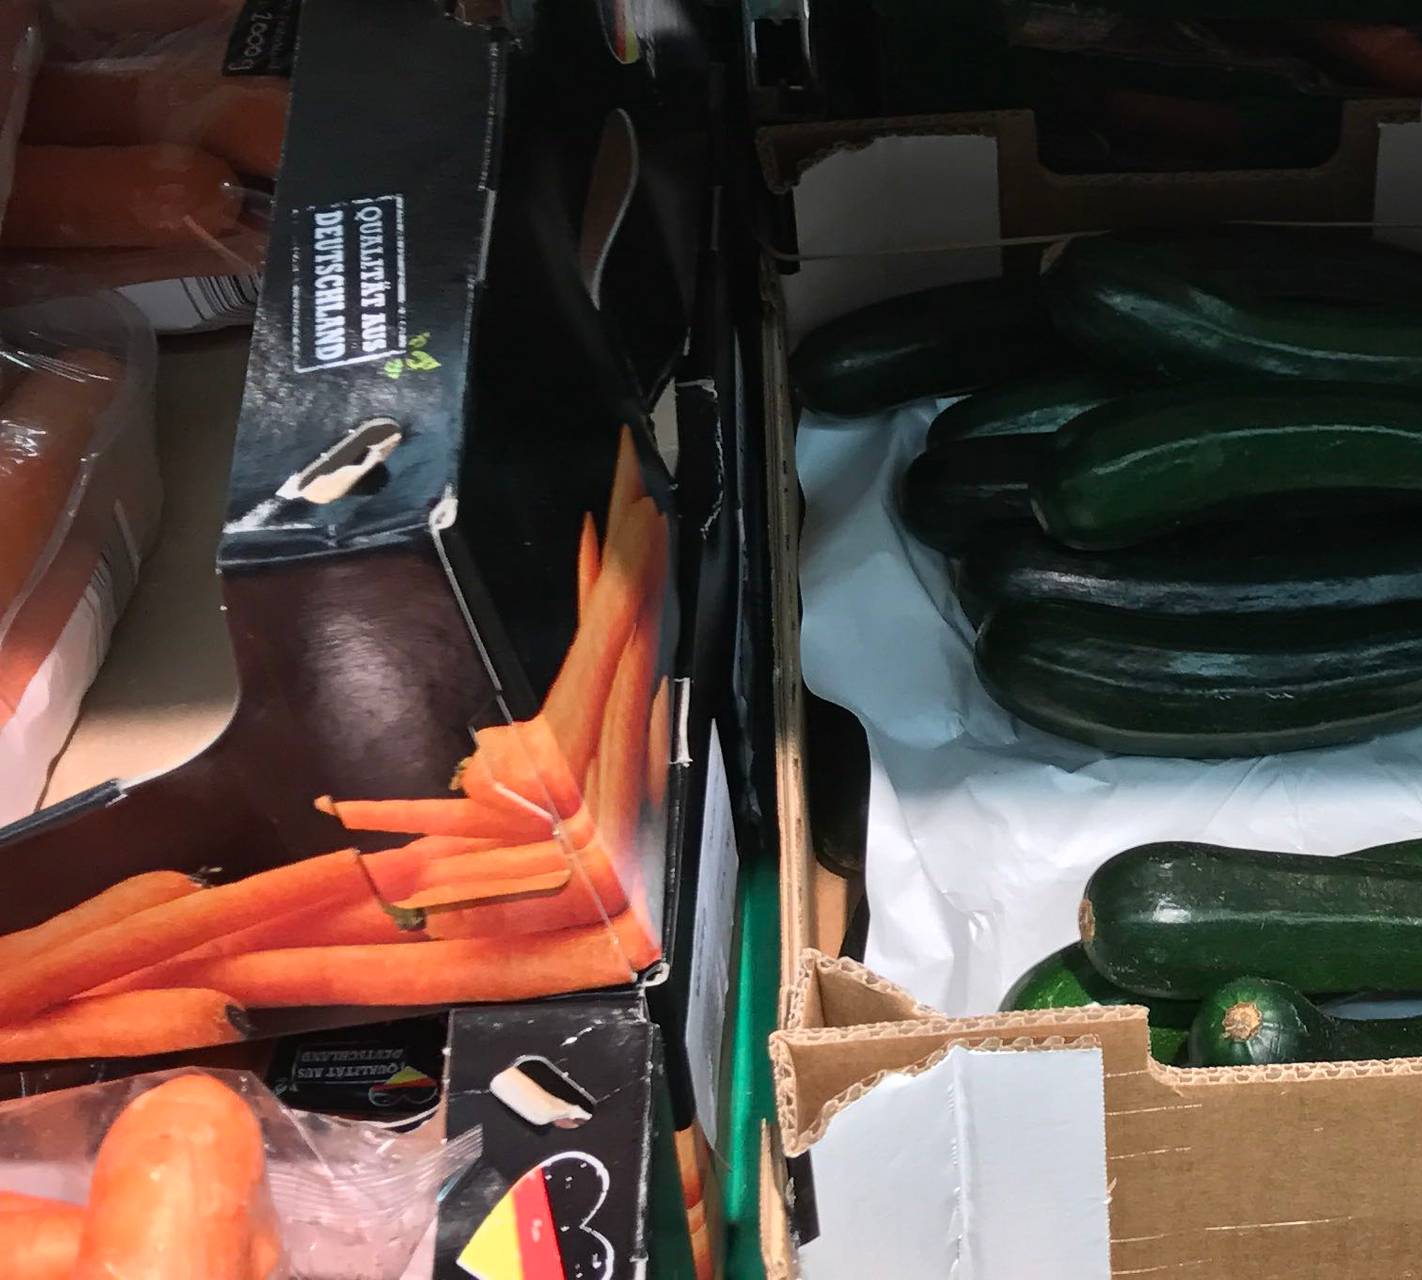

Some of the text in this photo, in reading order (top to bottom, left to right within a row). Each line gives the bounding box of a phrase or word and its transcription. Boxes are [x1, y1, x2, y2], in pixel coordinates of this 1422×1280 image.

[314, 210, 346, 361] DEUTSCHLAND
[354, 206, 391, 352] QUALITÄT AUS
[298, 1067, 324, 1079] AUS
